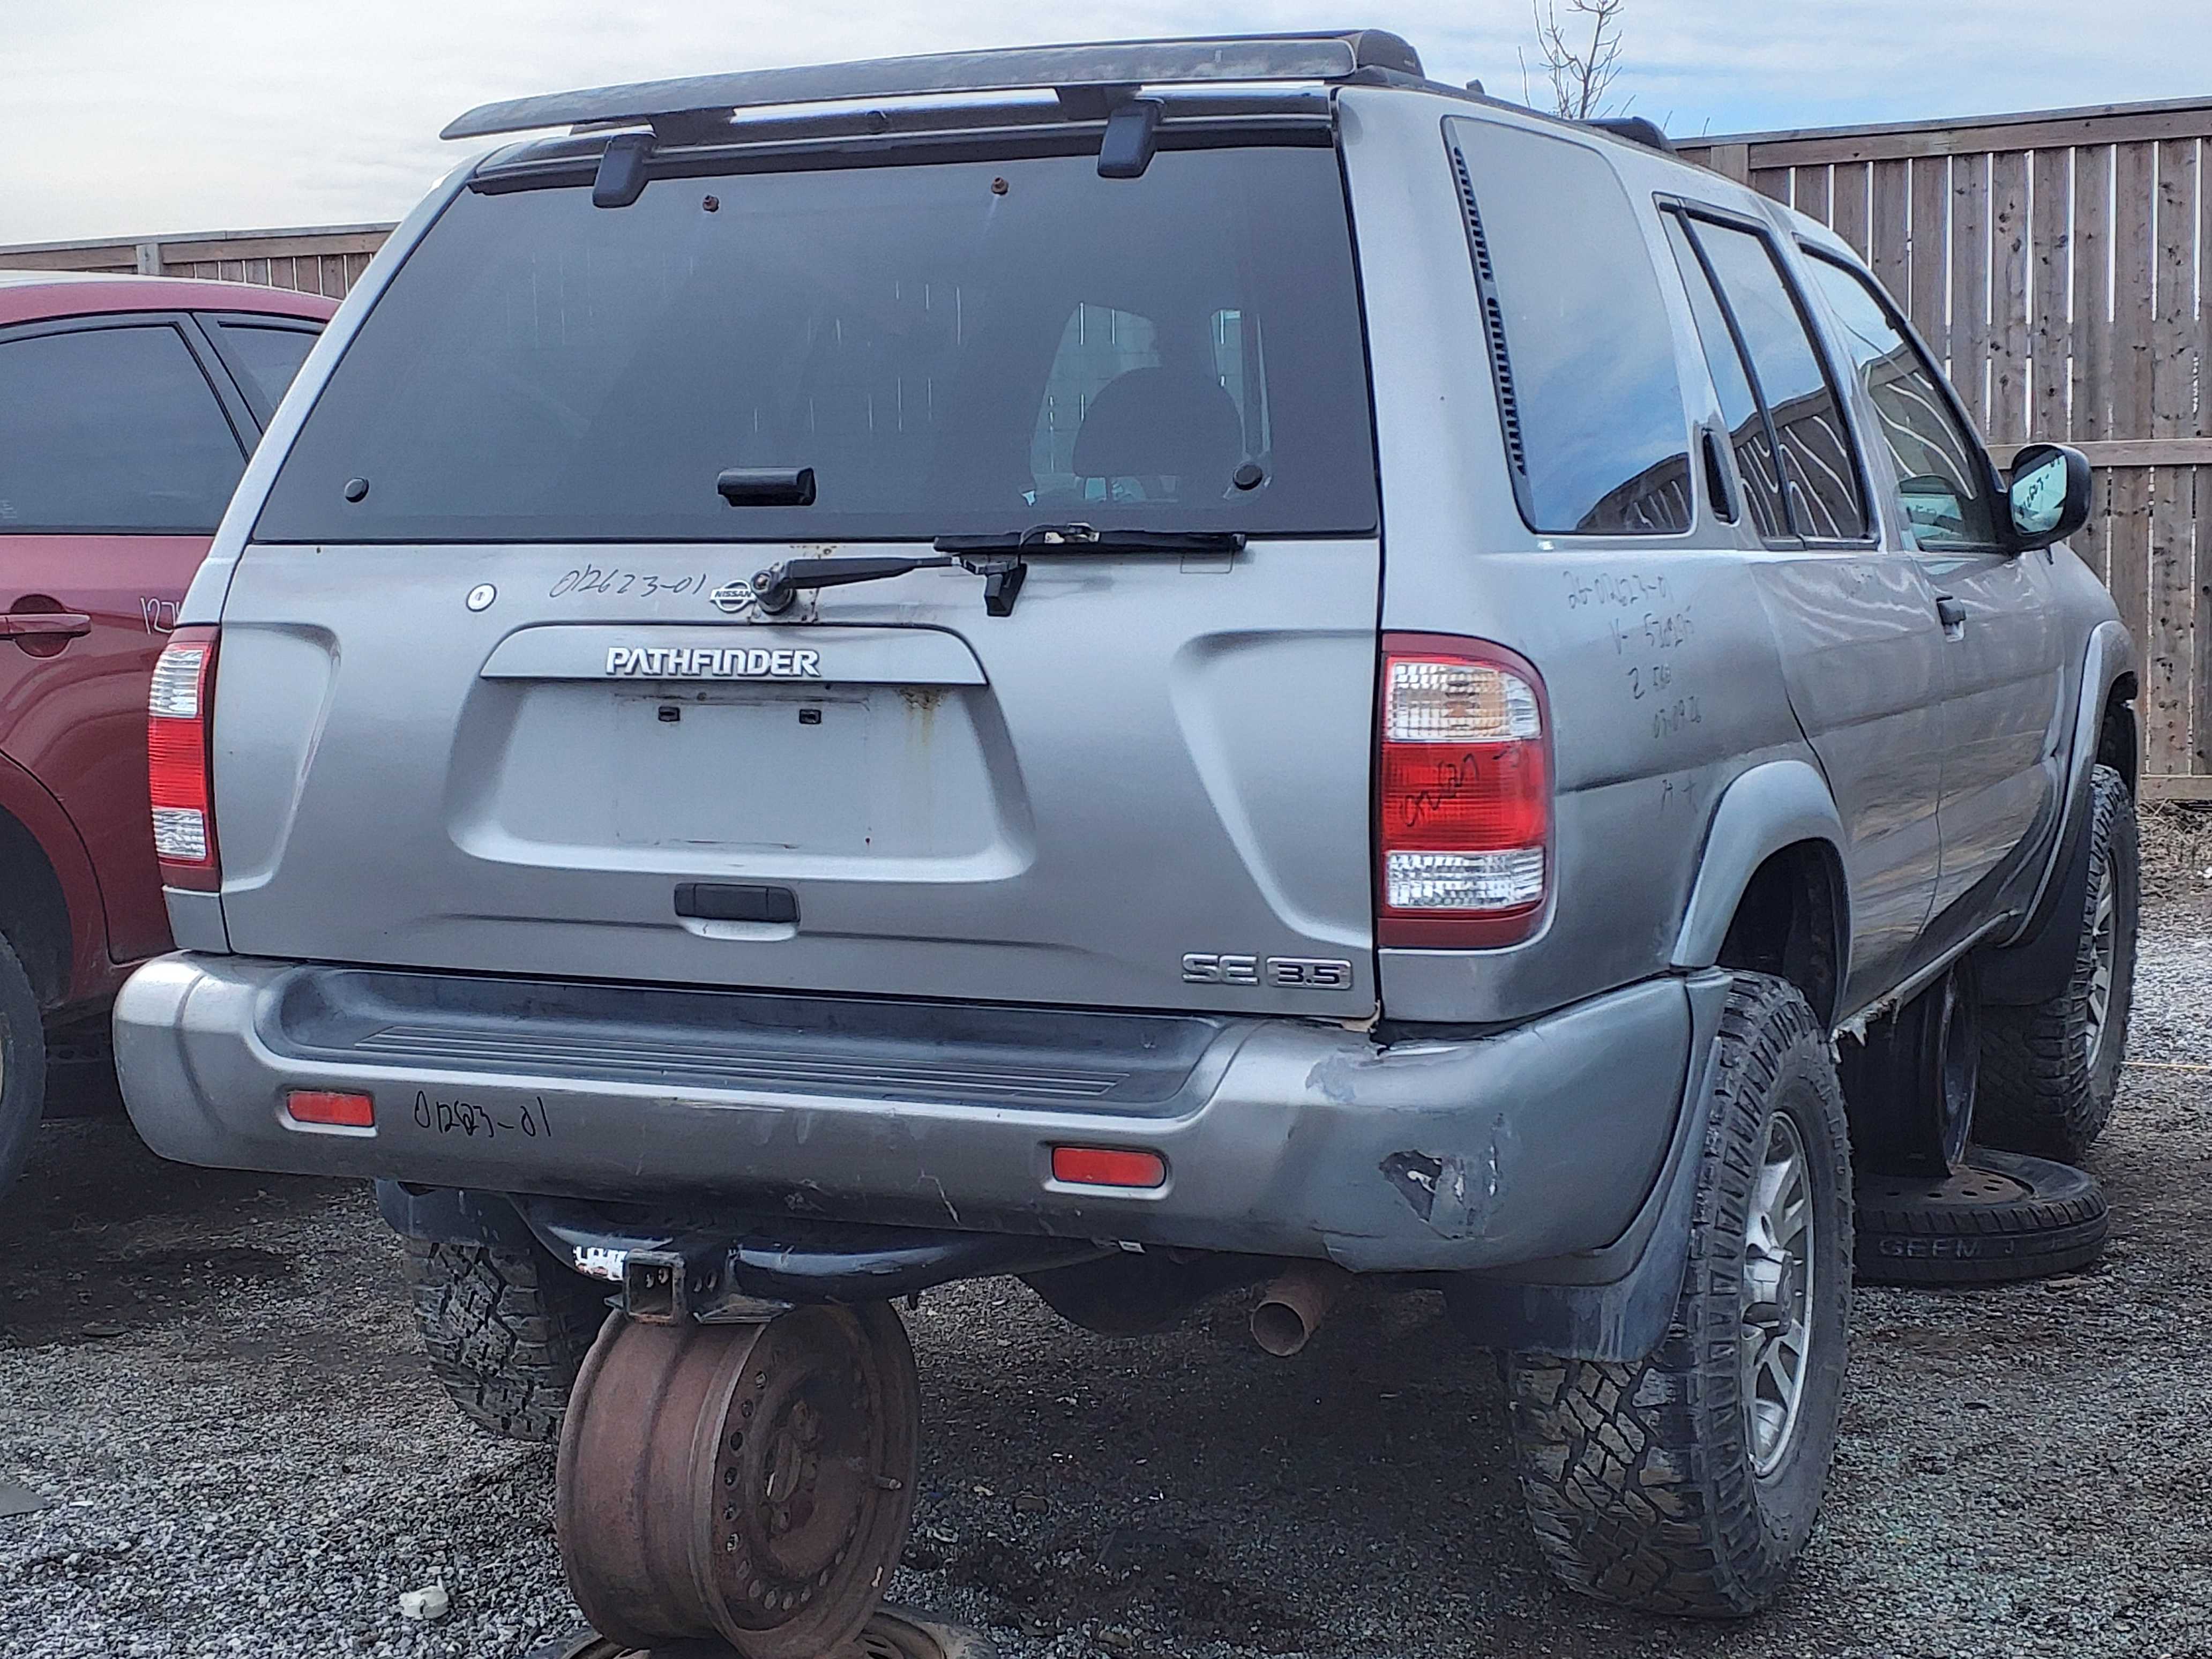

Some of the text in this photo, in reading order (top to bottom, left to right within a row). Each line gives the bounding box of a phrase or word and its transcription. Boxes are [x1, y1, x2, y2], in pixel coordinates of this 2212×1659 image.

[549, 564, 706, 597] 012623-01
[714, 590, 751, 598] NISSAN
[606, 647, 821, 677] PATHFINDER
[1182, 952, 1340, 985] SE 3.5
